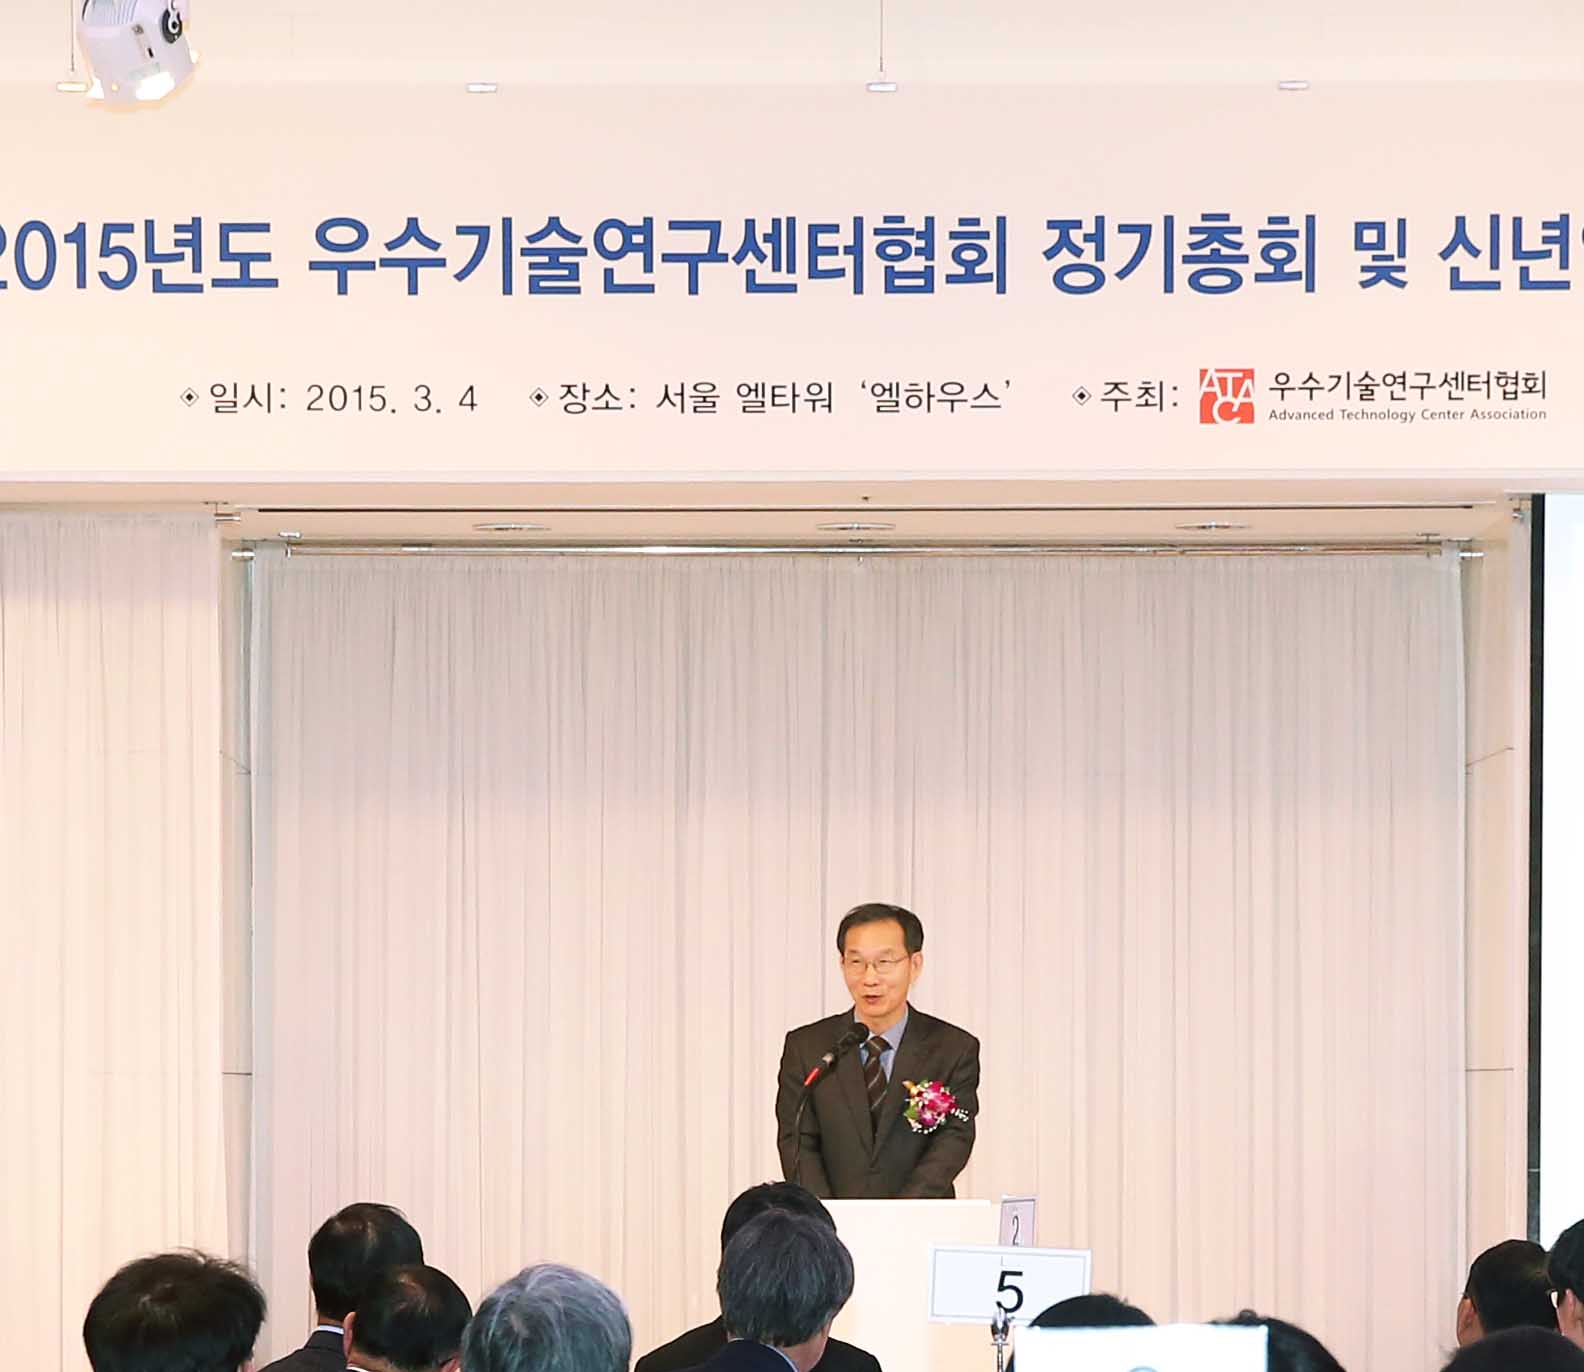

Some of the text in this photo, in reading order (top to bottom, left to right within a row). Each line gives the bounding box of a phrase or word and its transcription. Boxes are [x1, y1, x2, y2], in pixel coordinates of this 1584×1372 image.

[308, 214, 1008, 296] 우수기술연구센터협회
[1041, 213, 1317, 295] 정기총회
[1352, 216, 1409, 290] 및
[210, 382, 478, 414] 일시: 2015. 3. 4
[559, 382, 637, 415] 장소:
[656, 381, 722, 414] 서울
[736, 381, 833, 414] 엘타워
[1100, 380, 1179, 413] 주최:
[1268, 370, 1547, 402] 우수기술연구센터협회
[1268, 408, 1547, 424] Advanced Technology Center Association
[995, 1270, 1024, 1314] 5
